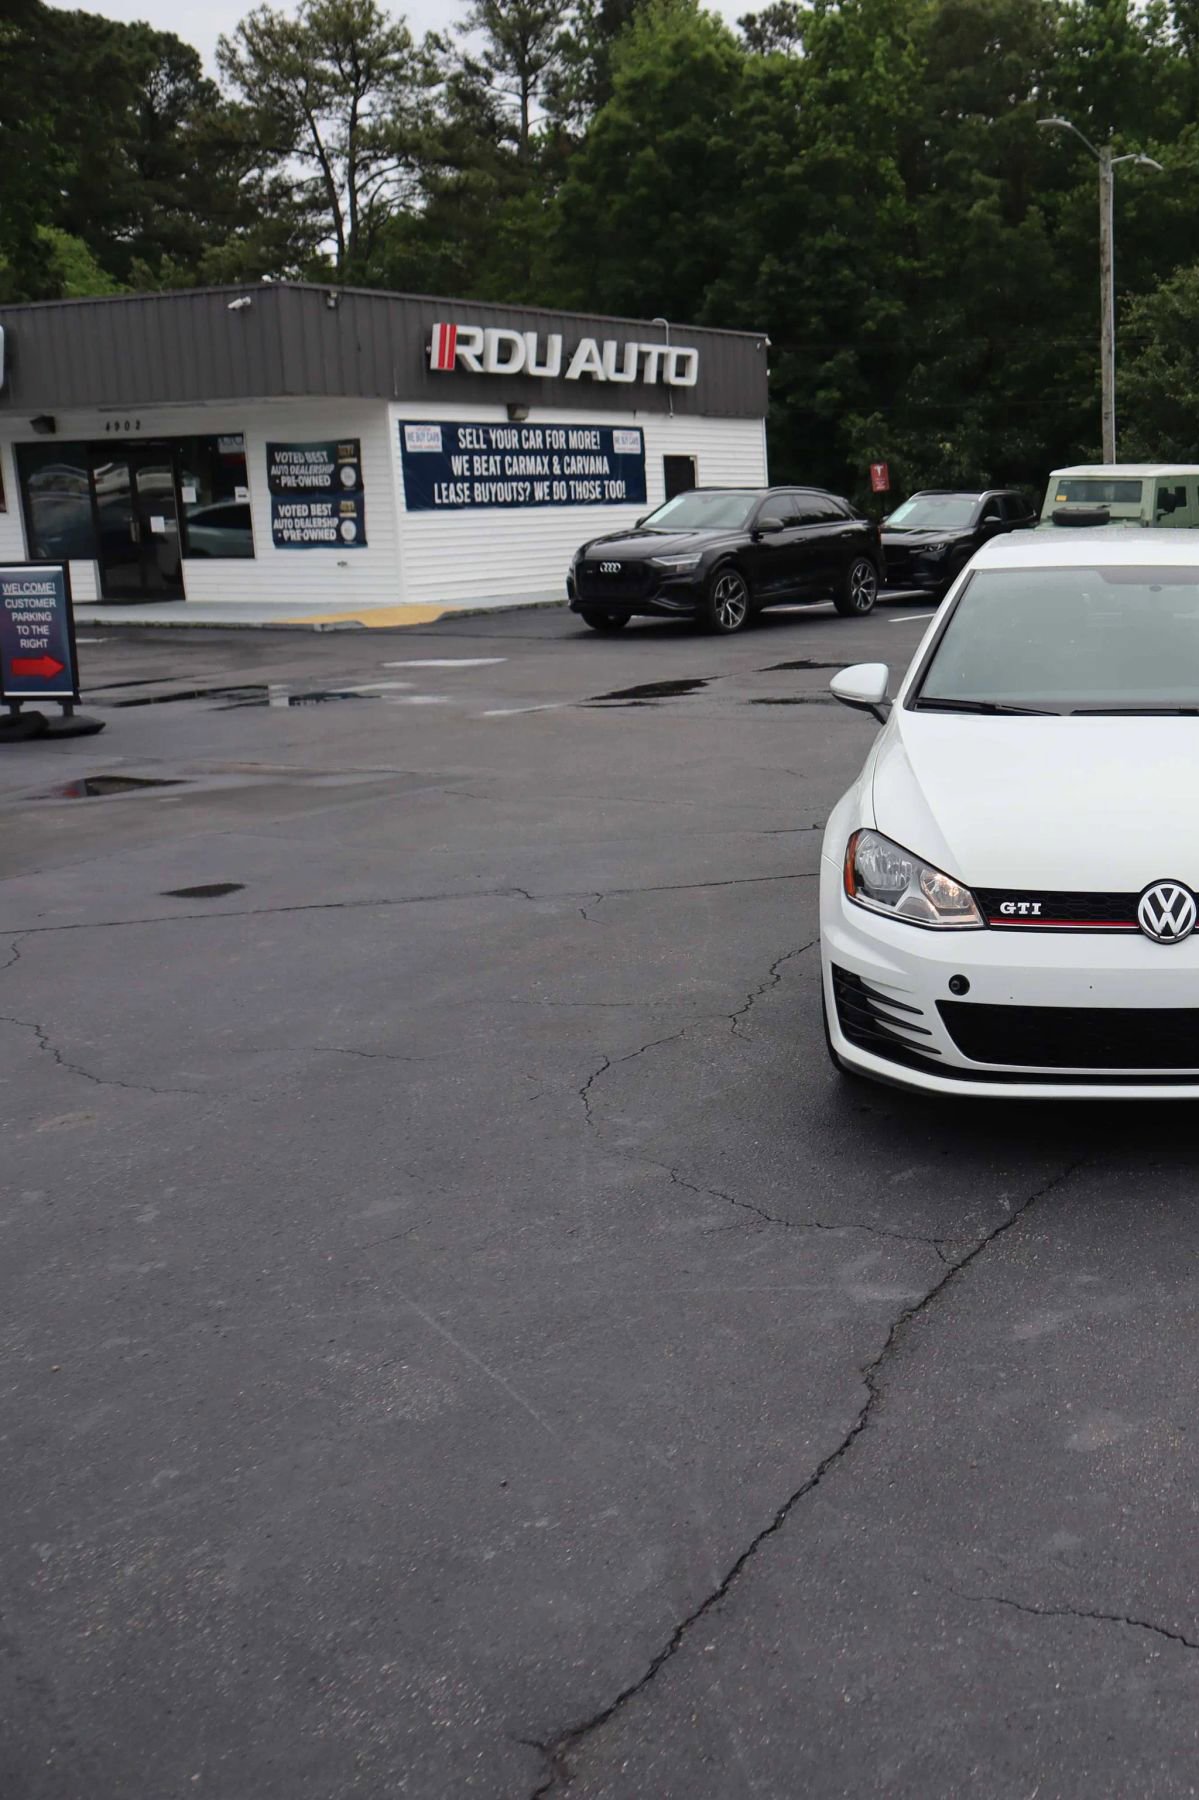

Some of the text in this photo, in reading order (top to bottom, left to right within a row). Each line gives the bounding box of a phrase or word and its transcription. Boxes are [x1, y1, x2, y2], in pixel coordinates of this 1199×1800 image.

[430, 323, 699, 386] RDU AUTO
[458, 428, 600, 450] SELL YOUR CAR FOR MORE!
[274, 452, 304, 464] VOTED
[304, 451, 329, 463] BEST
[271, 464, 335, 476] AUTO DEALERSHIP
[451, 456, 610, 476] WE BEAT CARMAX & CARVANA
[280, 475, 331, 488] PRE-OWNED
[434, 480, 626, 504] LEASE BUYOUTS? WE DO THOSE TOO!
[278, 504, 309, 517] VOTED
[310, 503, 333, 516] BEST
[273, 517, 339, 529] AUTO DEALERSHIP
[283, 528, 337, 541] PRE-OWNED
[2, 583, 56, 594] WELCOME!
[4, 598, 57, 609] CUSTOMER
[11, 612, 53, 622] PARKING
[16, 625, 50, 635] TO THE
[20, 638, 48, 649] RIGHT
[1000, 902, 1041, 915] GTI
